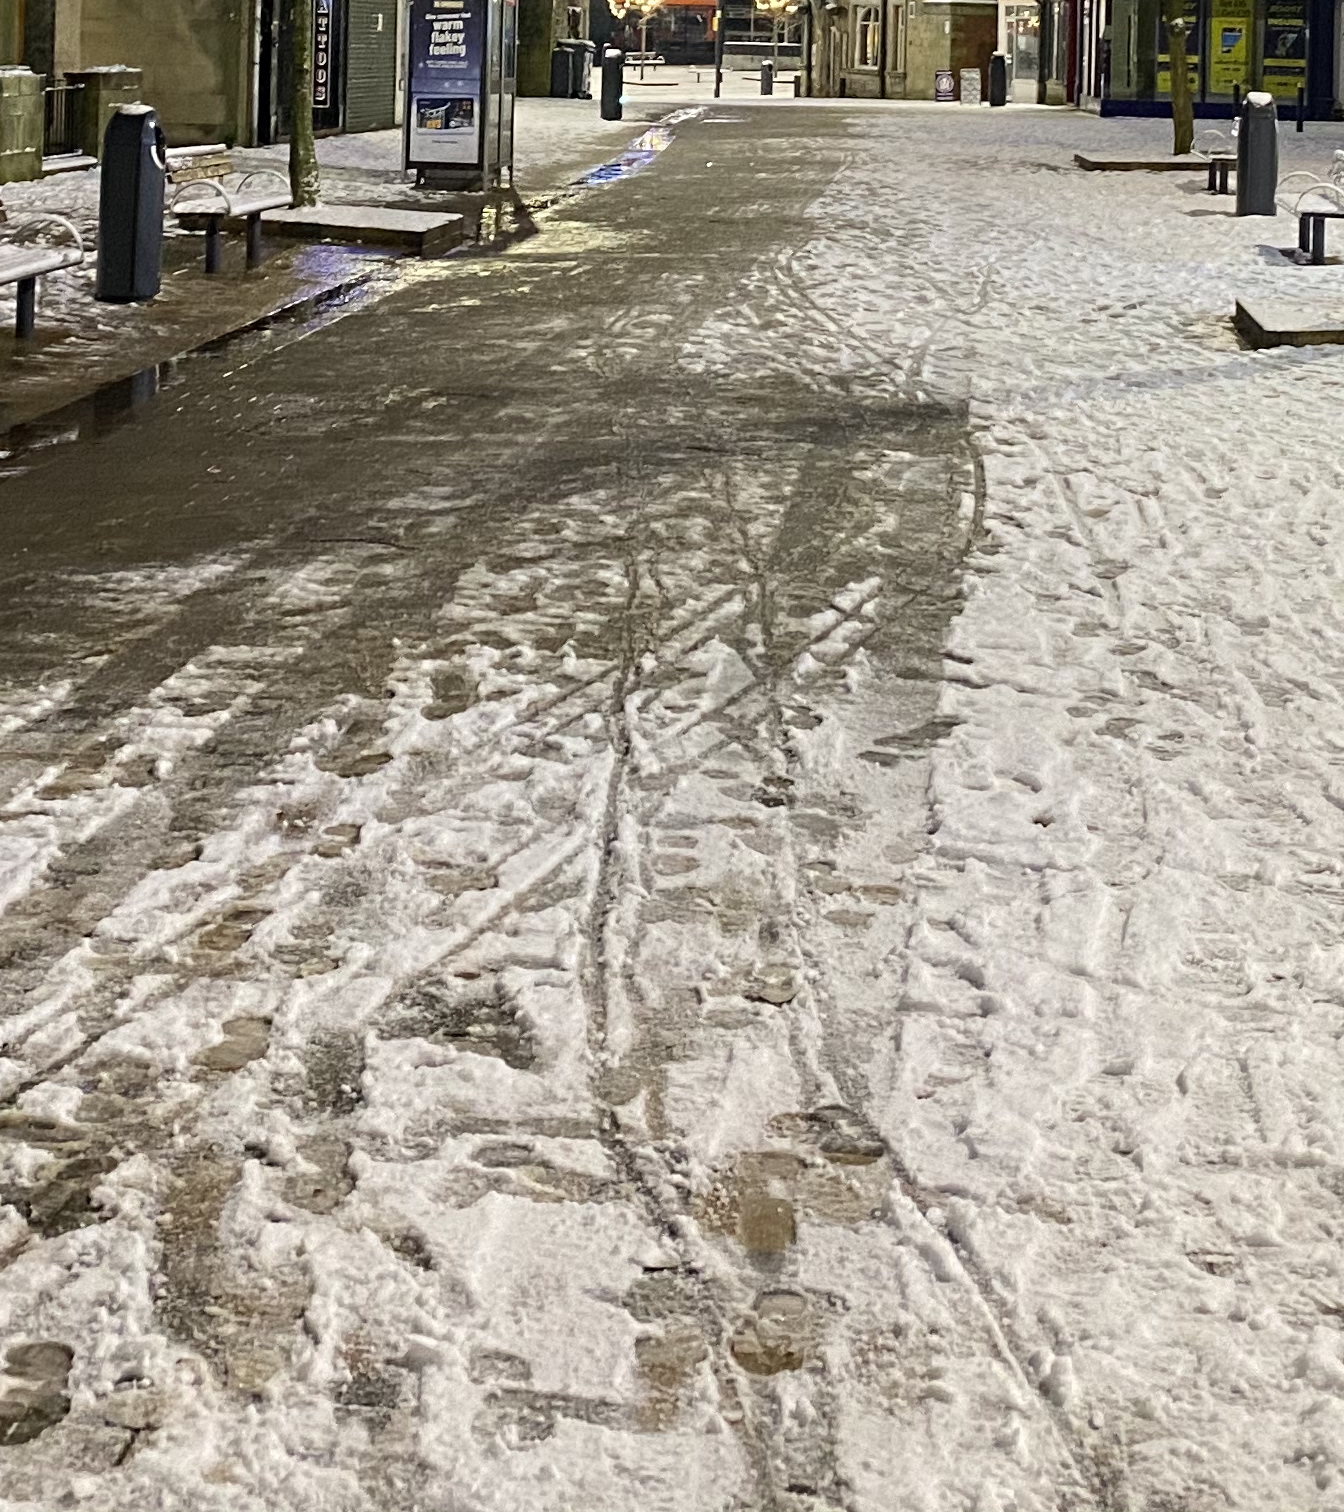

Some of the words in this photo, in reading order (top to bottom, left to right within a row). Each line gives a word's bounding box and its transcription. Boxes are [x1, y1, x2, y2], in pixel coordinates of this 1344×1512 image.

[433, 20, 464, 30] warm
[430, 31, 466, 44] flakey
[429, 43, 467, 57] feeling
